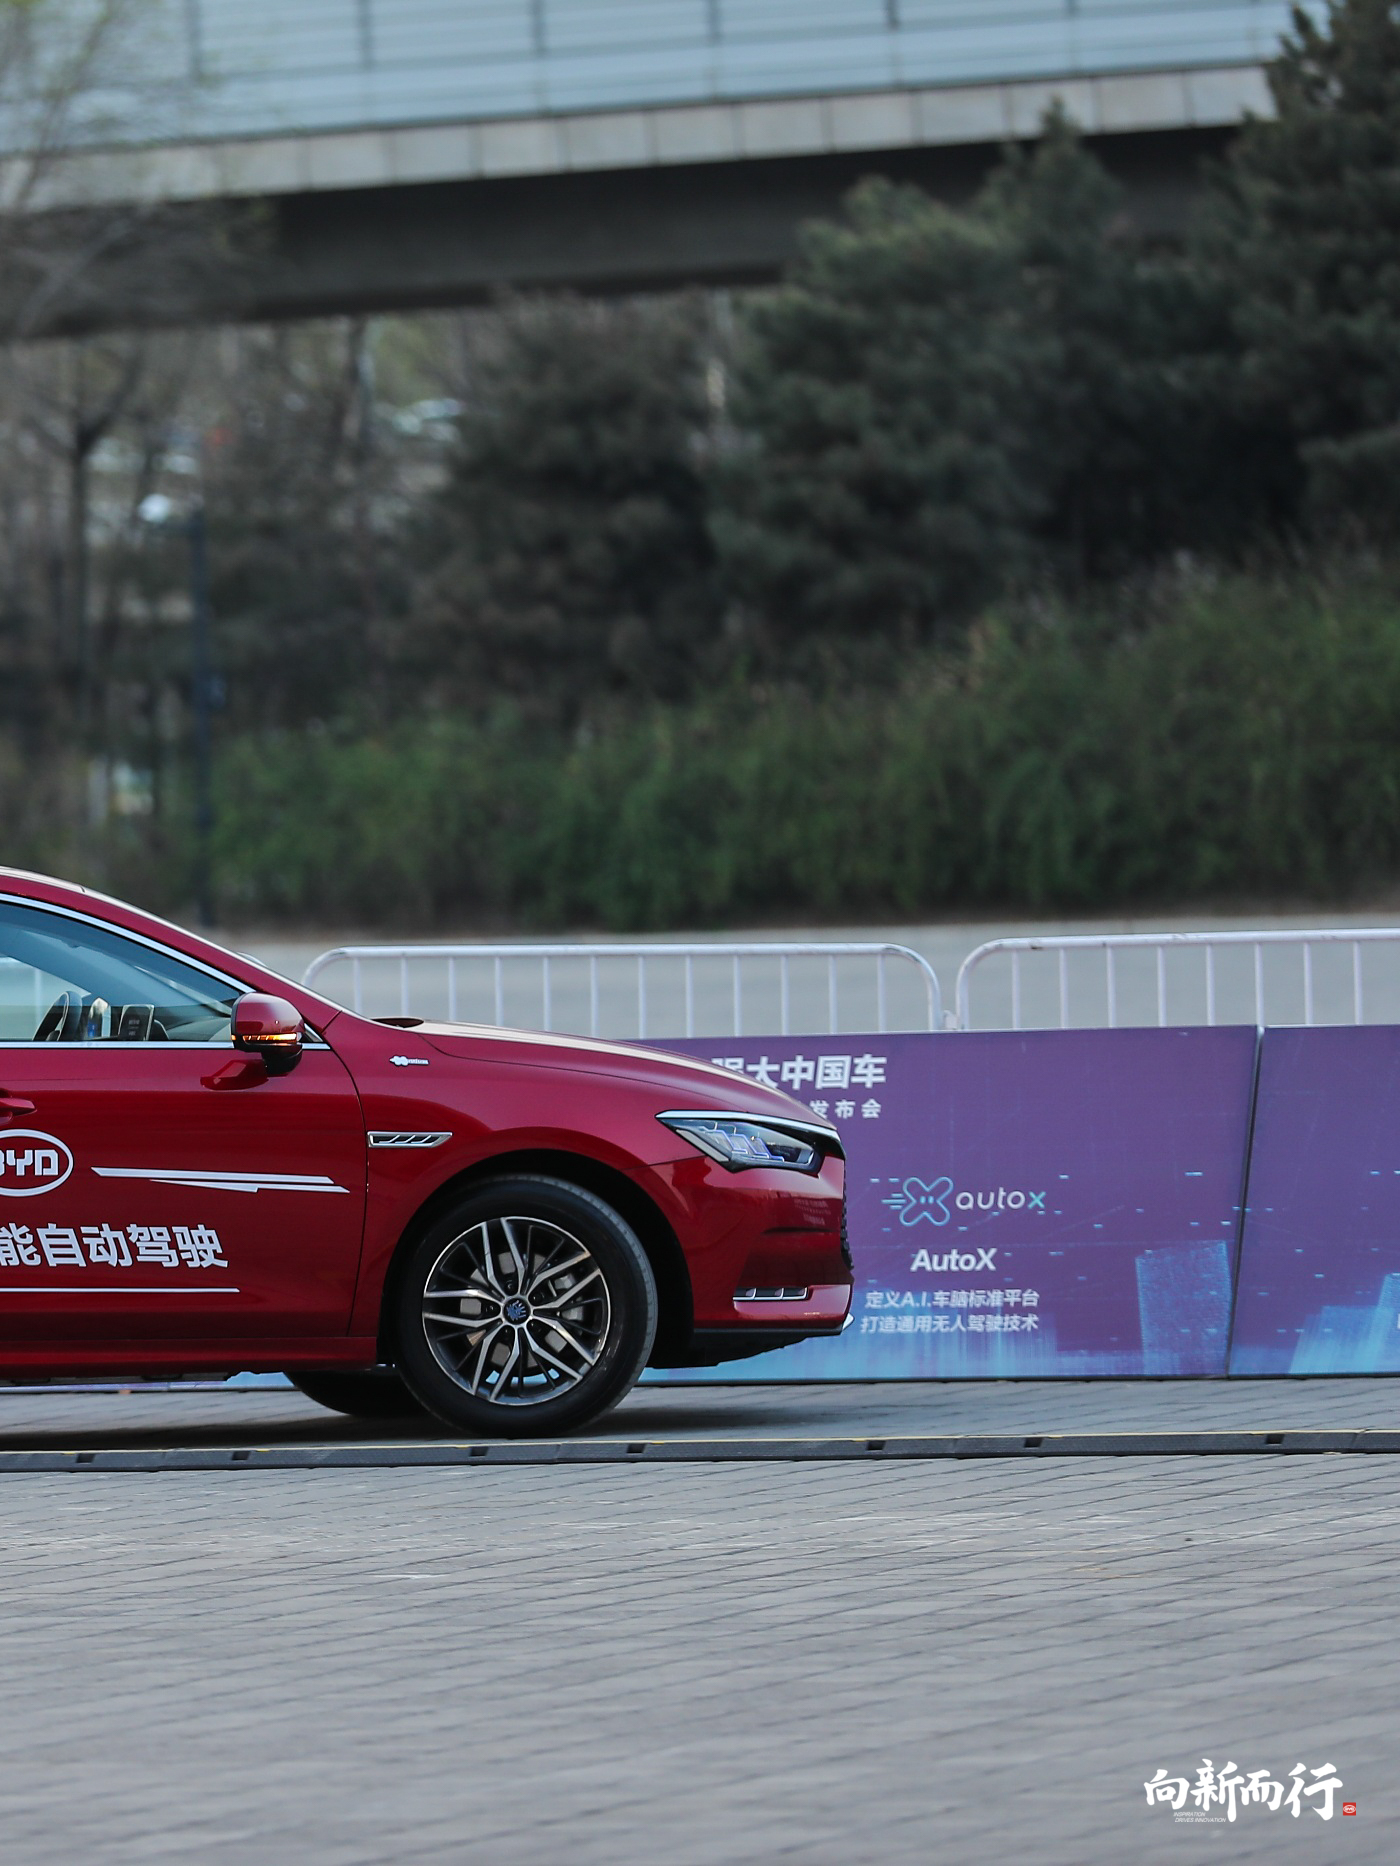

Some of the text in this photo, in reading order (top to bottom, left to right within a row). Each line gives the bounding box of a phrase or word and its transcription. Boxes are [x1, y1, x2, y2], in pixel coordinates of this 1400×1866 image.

[955, 1187, 1046, 1211] autox
[910, 1248, 997, 1272] AutoX
[860, 1313, 1040, 1334] 打造通用无人驾驶技术
